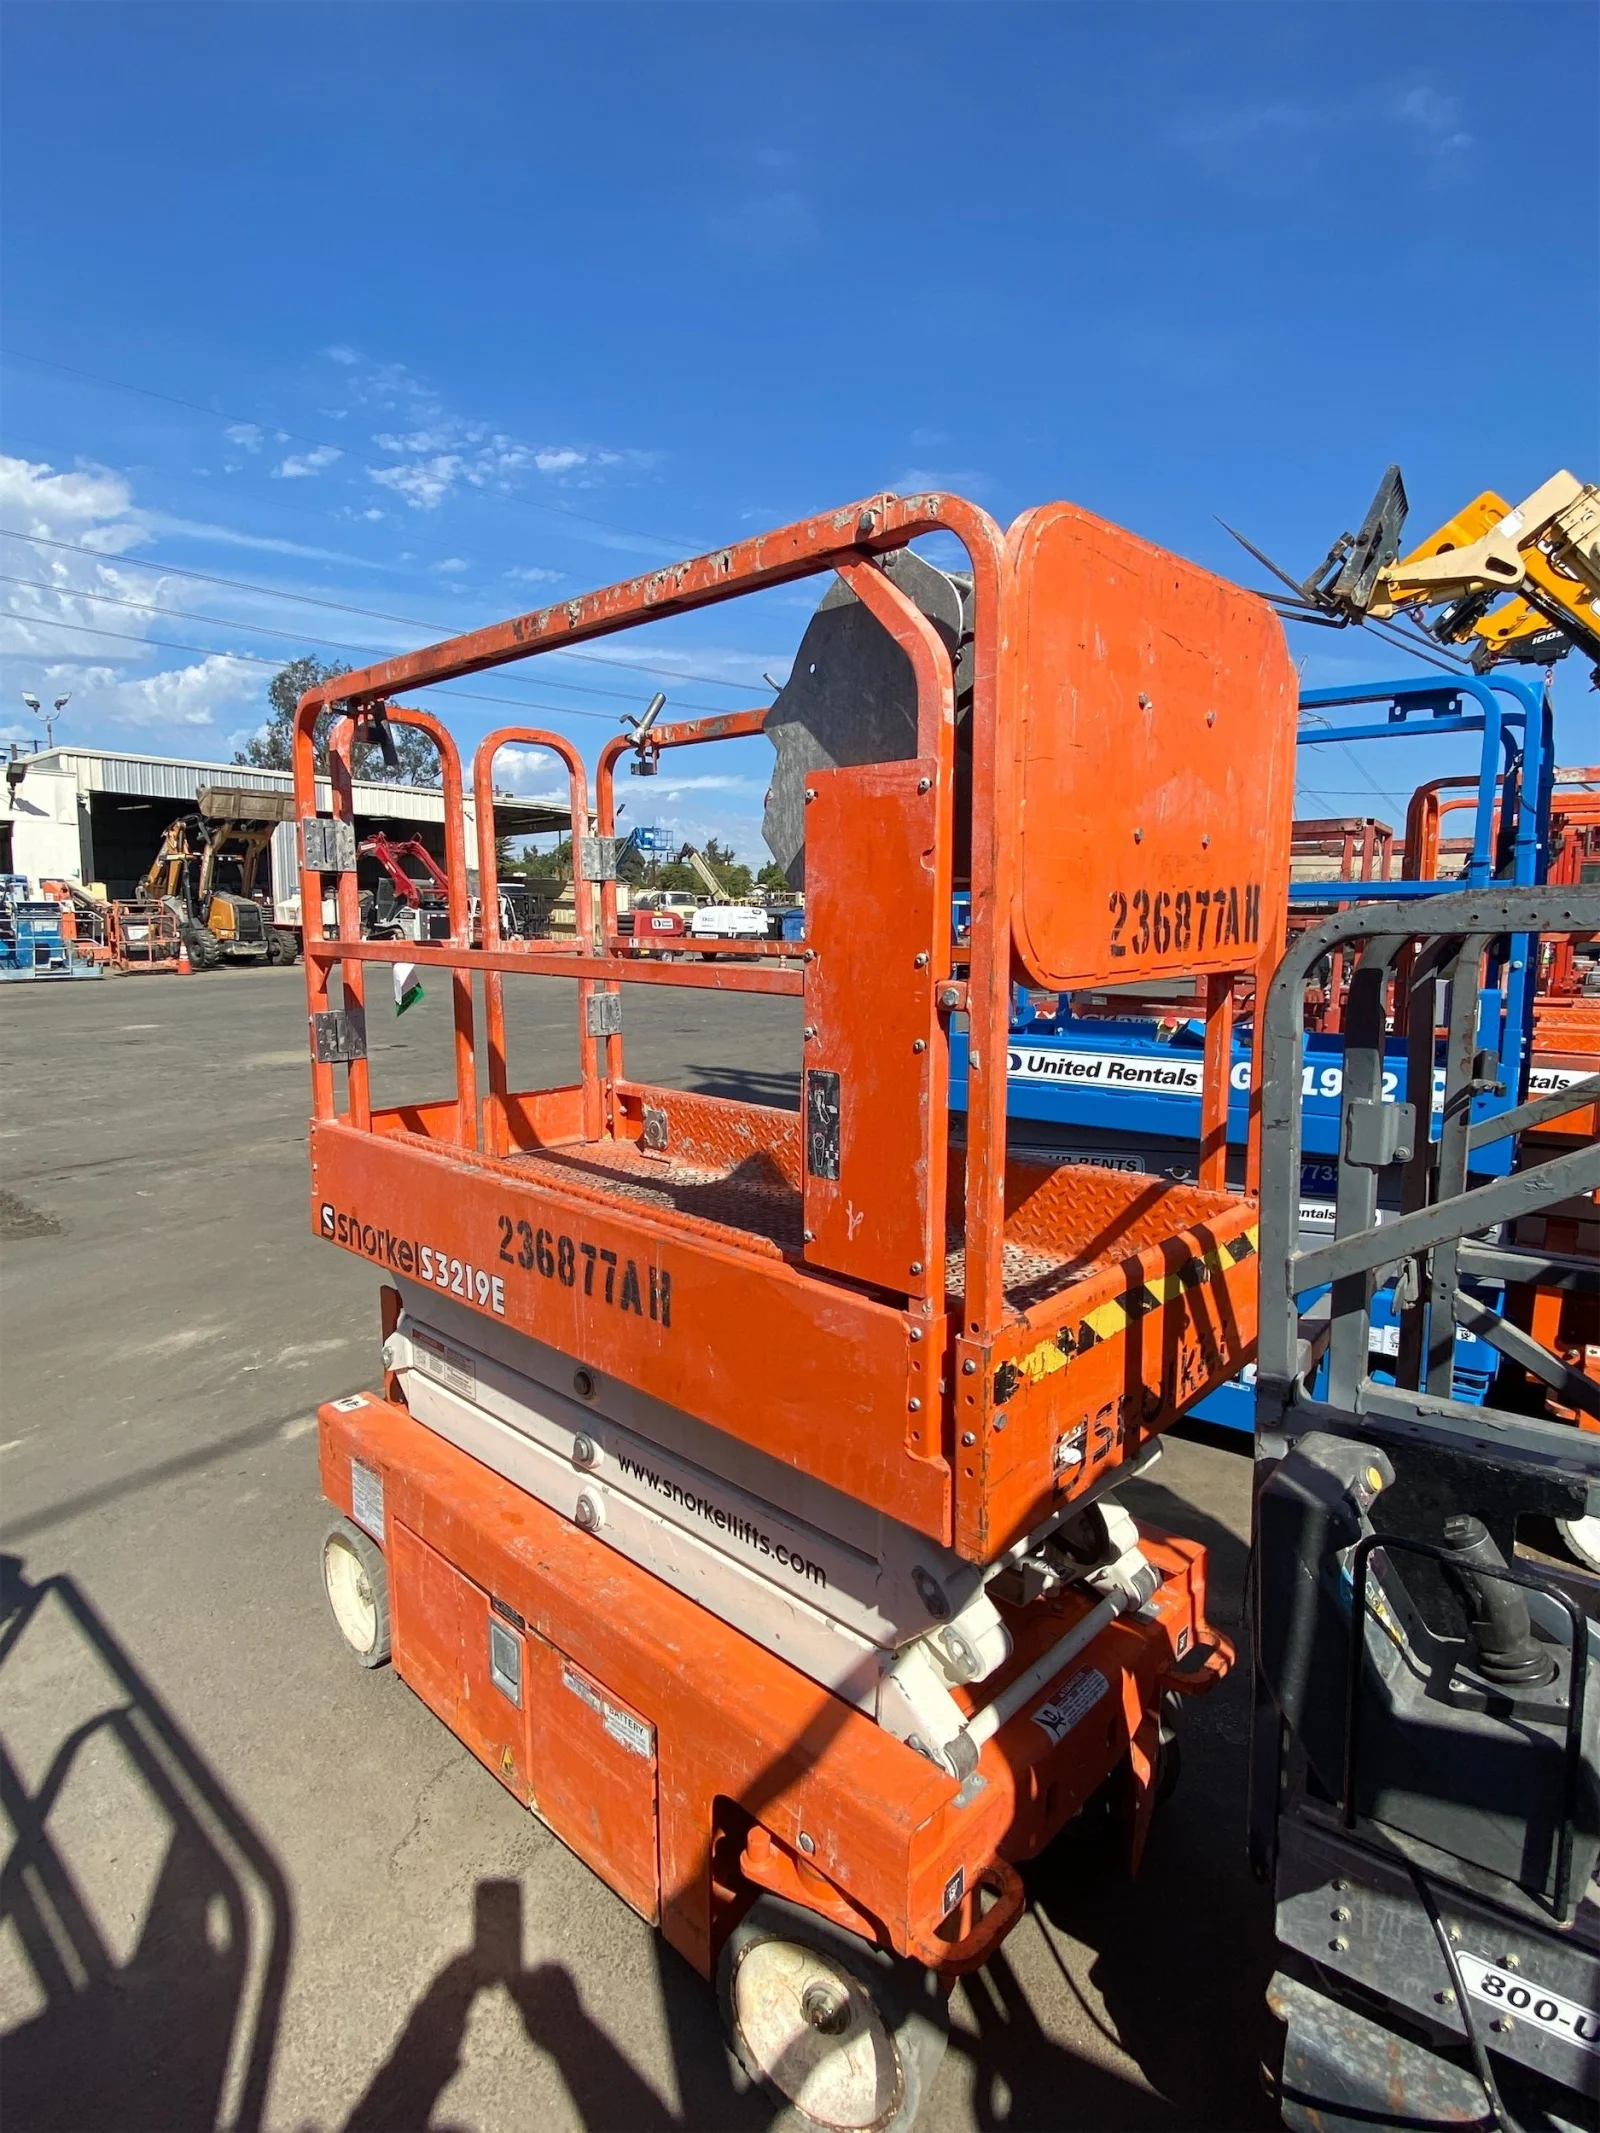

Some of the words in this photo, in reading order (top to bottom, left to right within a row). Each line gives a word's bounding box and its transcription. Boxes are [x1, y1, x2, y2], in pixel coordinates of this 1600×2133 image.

[1109, 884, 1261, 957] 236877AH
[1027, 1056, 1102, 1078] United
[1107, 1063, 1198, 1087] Rentals
[337, 1213, 420, 1276] snorkel
[420, 1246, 506, 1317] S3219E
[498, 1215, 672, 1328] 236877AH
[617, 1453, 827, 1589] www.snorkellifts.com
[608, 1706, 644, 1736] BATTERY
[1481, 1973, 1600, 2043] 800-U
